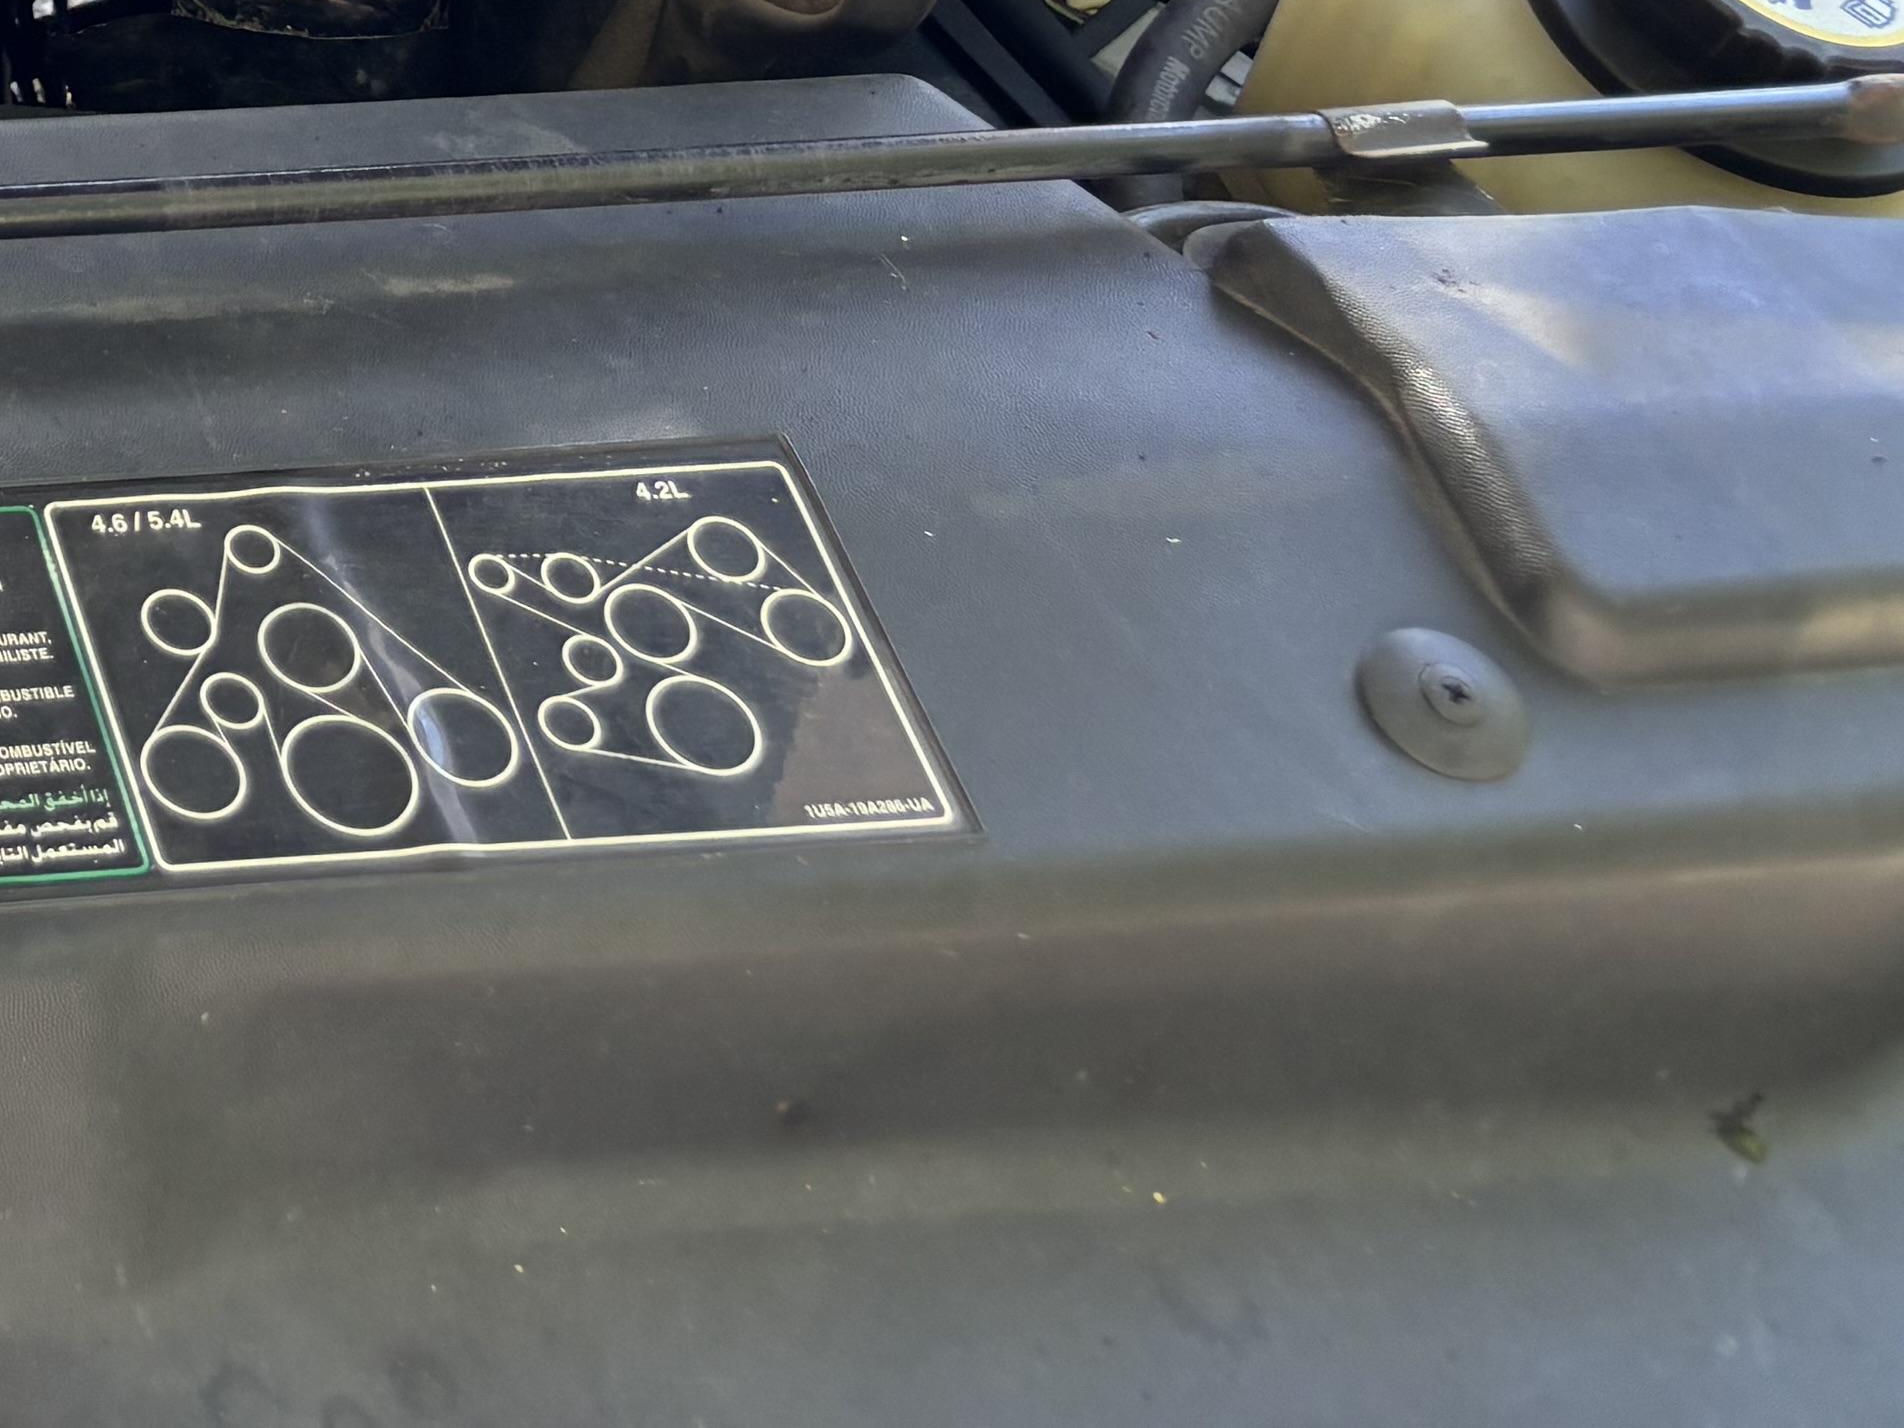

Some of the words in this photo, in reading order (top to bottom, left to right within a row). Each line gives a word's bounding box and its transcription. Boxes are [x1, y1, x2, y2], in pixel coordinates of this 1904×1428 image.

[636, 480, 690, 501] 4.2L
[90, 513, 129, 533] 4.6
[149, 509, 201, 531] 5.4L
